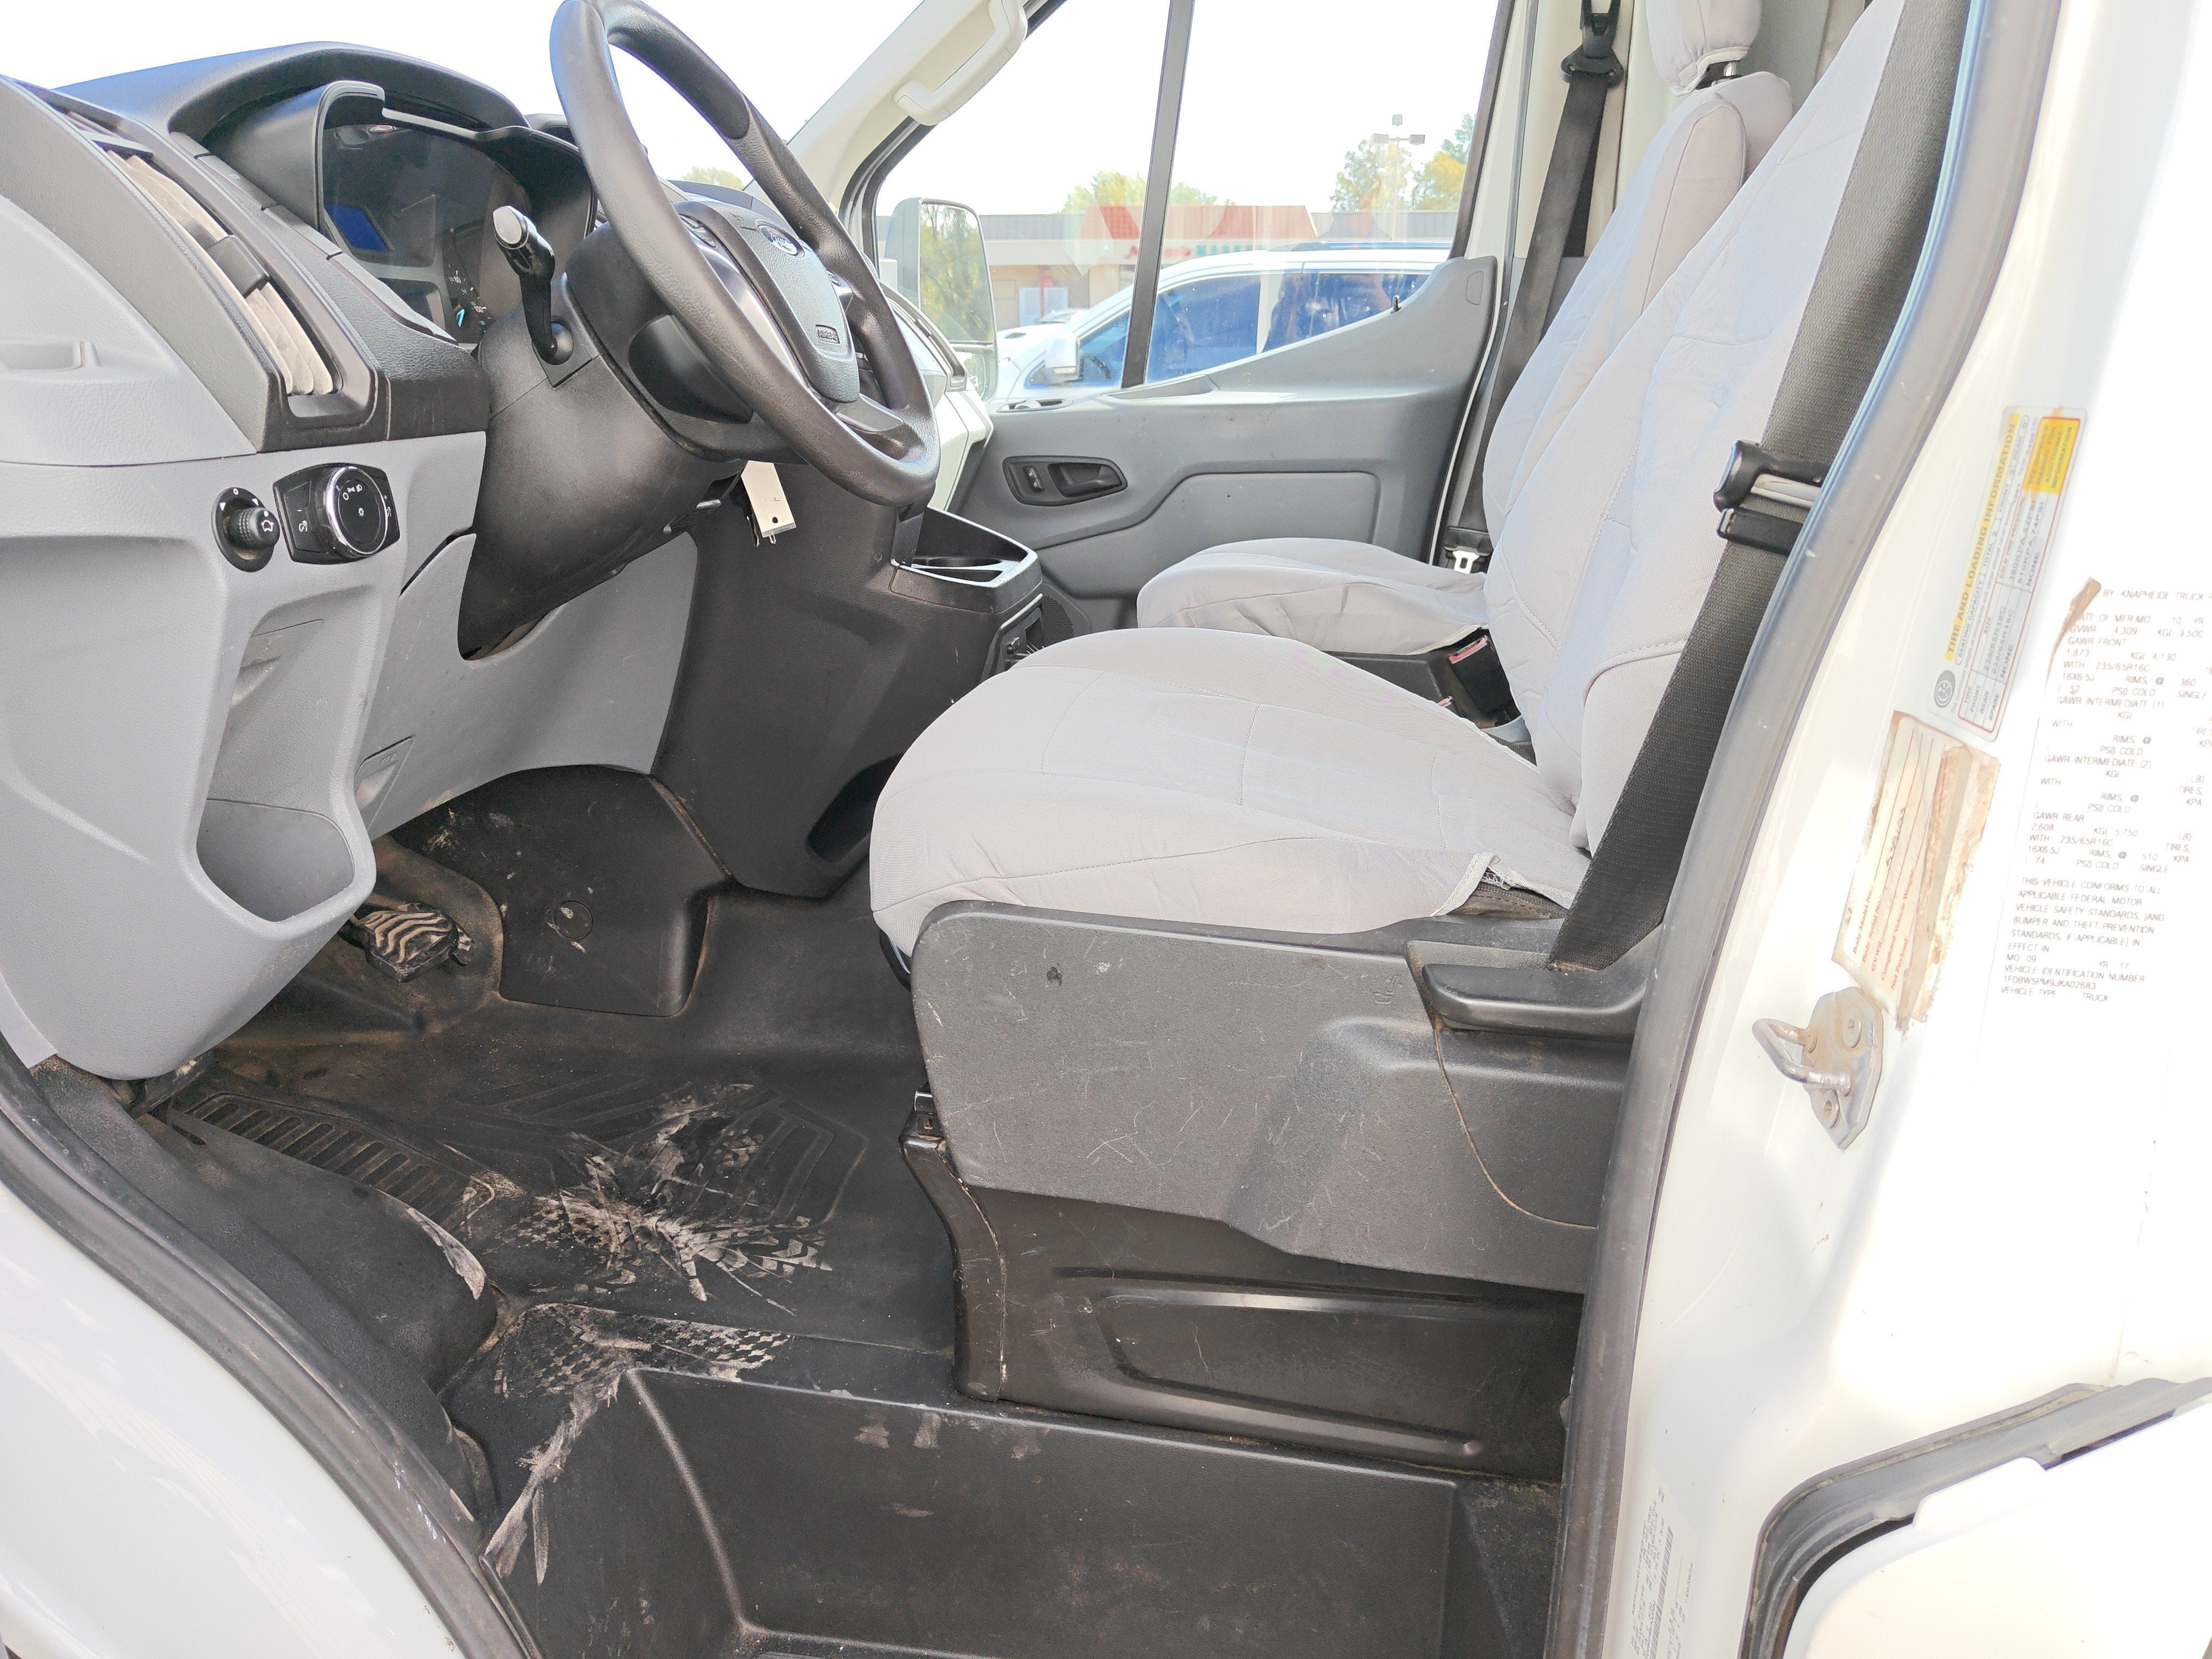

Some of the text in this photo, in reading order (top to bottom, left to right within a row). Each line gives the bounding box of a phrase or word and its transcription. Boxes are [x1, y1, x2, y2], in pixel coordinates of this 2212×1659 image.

[819, 329, 838, 341] AIRBAG
[1946, 423, 2016, 653] TIRE AND LOADING INFORMATION
[1982, 543, 1993, 568] TOTAL
[1957, 580, 1982, 658] SEATING CAPACITY
[2099, 614, 2109, 622] OF
[1987, 552, 2040, 721] SPARE NONE NONE
[2068, 637, 2126, 646] GAWR FRONT
[2132, 688, 2156, 696] COLD
[2056, 696, 2082, 704] GAWR
[2120, 747, 2143, 756] COLD
[2045, 754, 2070, 763] GAWR
[2074, 756, 2135, 767] INTERMEDIATE
[2108, 804, 2130, 813] COLD
[2033, 812, 2085, 821] GAWR REAR
[2029, 834, 2049, 842] WITH
[2060, 835, 2113, 846] 235/65R16C
[2173, 855, 2189, 864] KPA
[2096, 861, 2119, 870] COLD
[2140, 864, 2168, 873] SINGLE
[2022, 877, 2039, 886] THIS
[2044, 878, 2075, 888] VEHICLE
[2081, 881, 2129, 892] CONFORMS
[2148, 886, 2160, 894] ALL
[2018, 890, 2142, 906] APPLICABLE FEDERAL MOTOR
[2017, 903, 2048, 913] VEHICLE
[2054, 906, 2084, 914] SAFETY
[1852, 932, 1862, 954] Body
[1858, 905, 1869, 931] Model
[2013, 916, 2155, 934] BUMPER AND THEFT PREVENTION
[1861, 941, 1871, 962] Body
[1867, 915, 1877, 939] Serial
[1880, 935, 1897, 980] Completed
[1893, 902, 1905, 933] Vehicle
[2132, 938, 2140, 946] IN
[2008, 942, 2038, 951] EFFECT
[2005, 964, 2144, 982] VEHICLE IDENTIFICATION NUMBER
[1890, 974, 1898, 990] Net
[2001, 986, 2109, 1002] VEHICLE TYPE TRUCK
